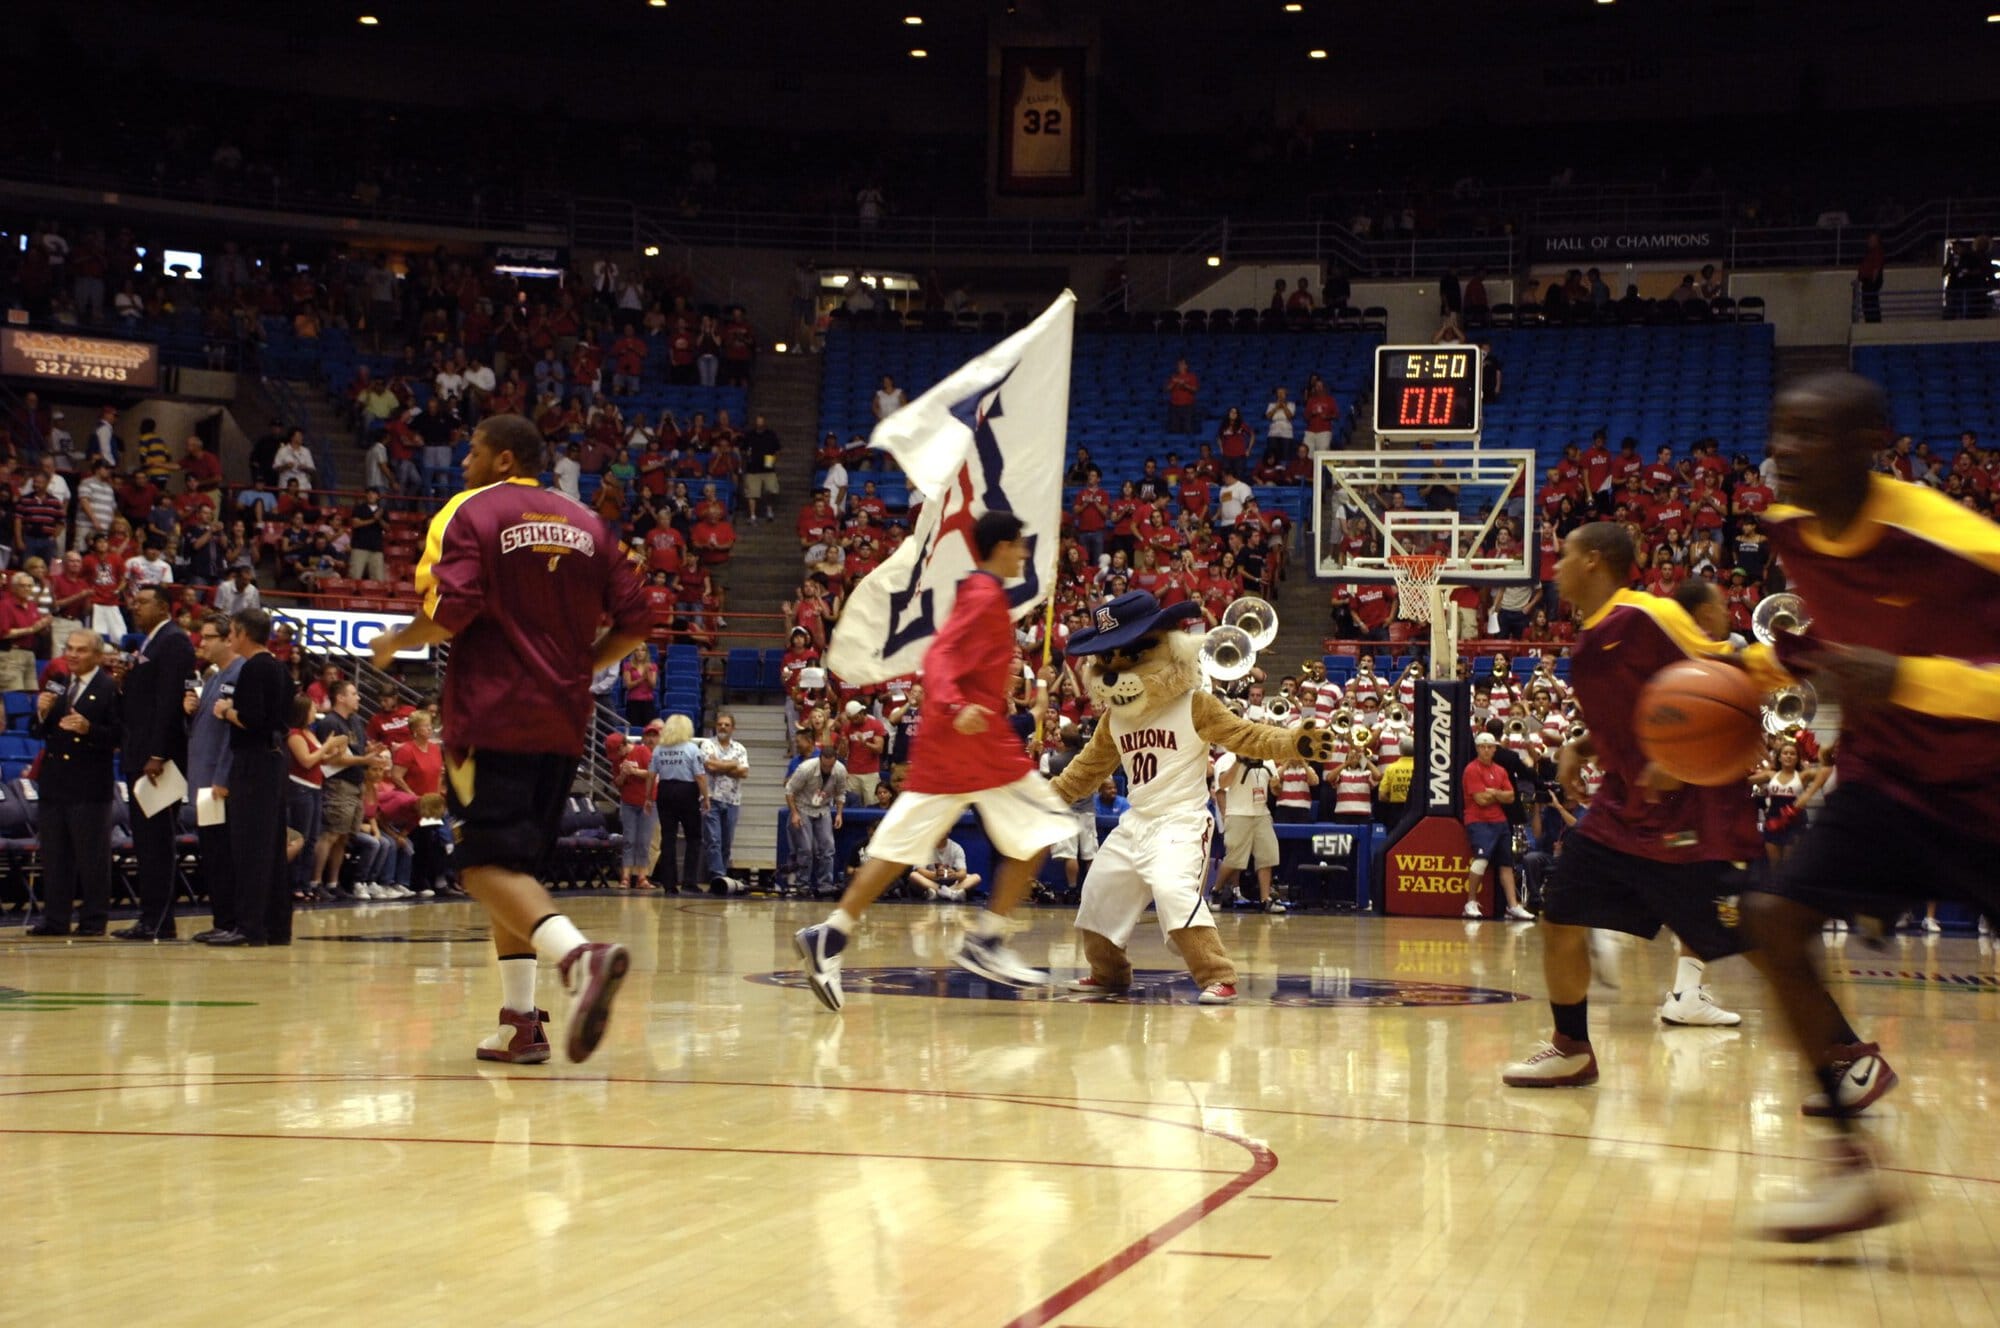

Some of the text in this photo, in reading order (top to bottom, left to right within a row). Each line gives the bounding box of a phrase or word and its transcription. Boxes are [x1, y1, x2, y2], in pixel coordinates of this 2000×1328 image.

[1024, 109, 1061, 135] 32
[1545, 233, 1710, 251] HALL OF CHAMPIONS
[35, 359, 127, 381] 327-7463
[1406, 354, 1466, 378] 5:50
[1400, 387, 1454, 424] 00
[1095, 606, 1119, 633] A
[1528, 648, 1541, 658] 21
[1120, 728, 1178, 754] ARIZONA
[1429, 689, 1452, 808] ARIZONA
[1132, 751, 1157, 785] 00
[1311, 833, 1353, 856] FSN
